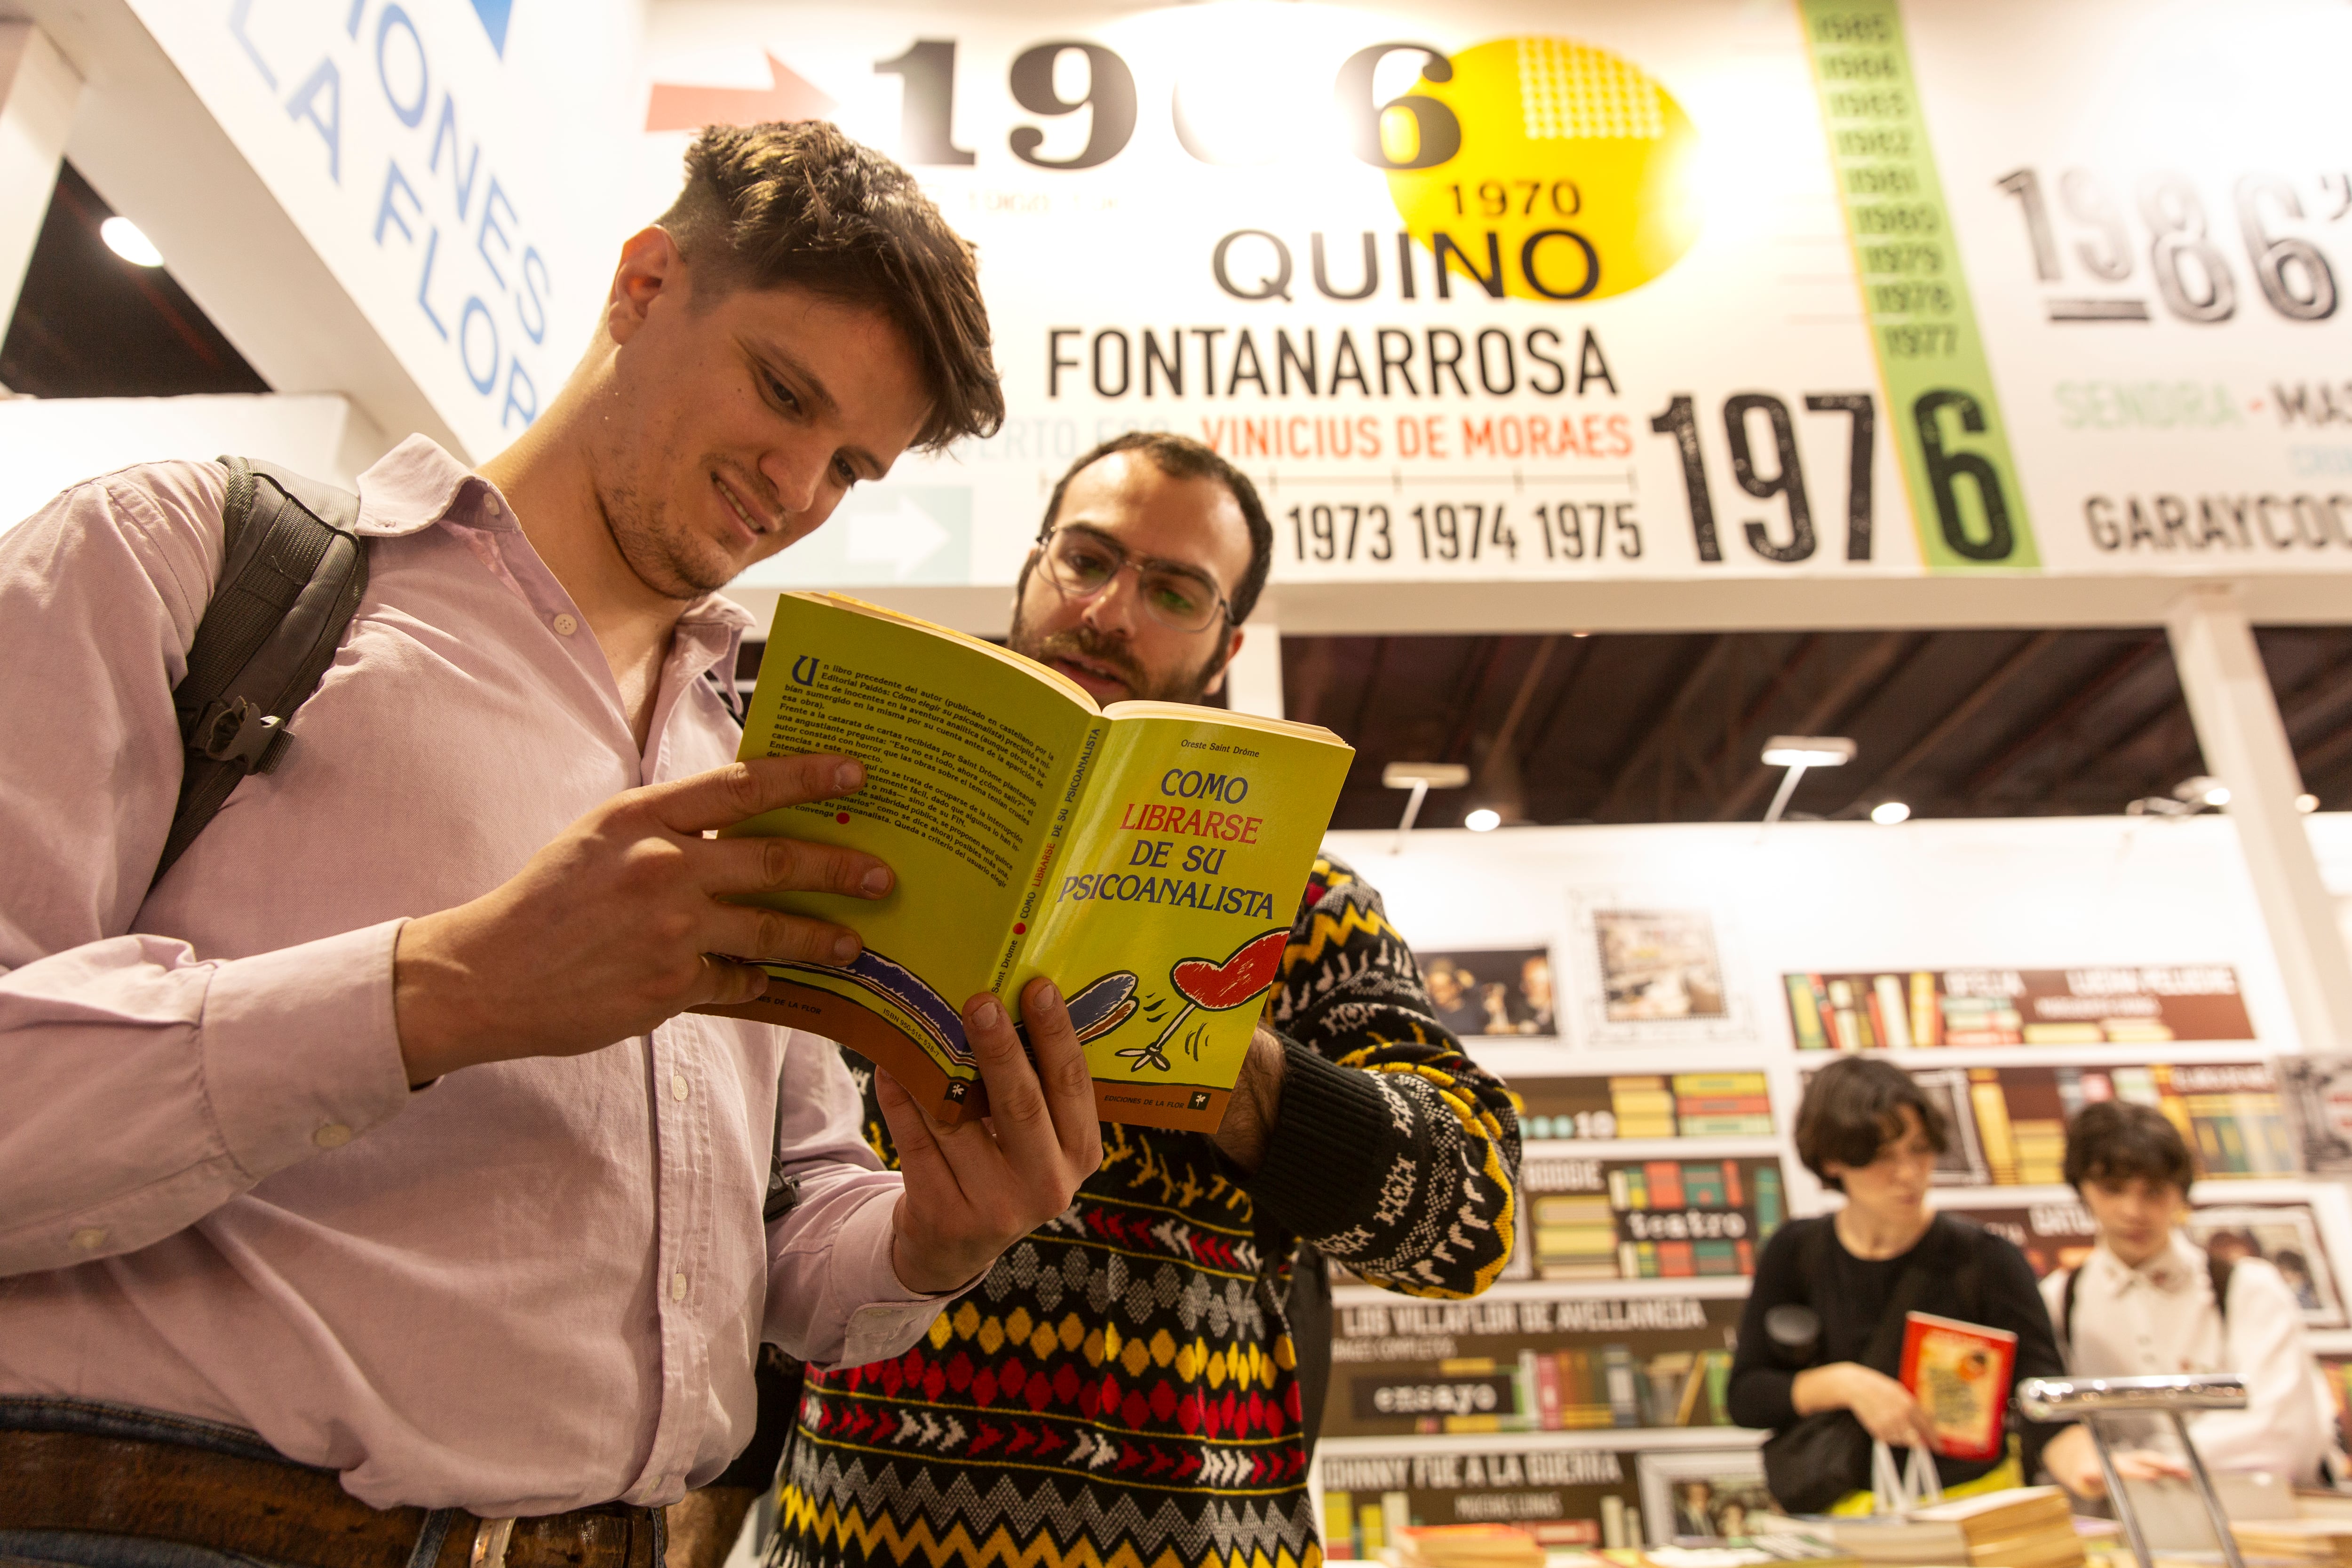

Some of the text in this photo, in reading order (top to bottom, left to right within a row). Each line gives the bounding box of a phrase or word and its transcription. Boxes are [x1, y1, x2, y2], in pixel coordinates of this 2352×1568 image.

[874, 37, 1462, 170] 196
[1449, 182, 1581, 215] 1970
[1213, 228, 1601, 303] QUINO
[1049, 327, 1618, 398] FONTANARROSA
[1201, 416, 1380, 459] VINICIUS
[1397, 416, 1447, 459] DE
[1462, 415, 1633, 458] MORAES
[1649, 389, 2017, 563] 1976
[1288, 502, 1643, 561] 1973 1974 1975
[781, 694, 825, 710] esa obra).
[821, 672, 858, 688] Editorial
[859, 681, 891, 696] Paidós:
[892, 691, 917, 704] Cómo
[917, 700, 942, 712] elegir
[941, 708, 953, 717] su
[952, 713, 1005, 742] psicoanalista)
[1004, 738, 1035, 759] precipitó
[1040, 759, 1051, 770] mi-
[832, 664, 853, 676] libro
[854, 672, 903, 690] precedente
[904, 685, 919, 695] del
[920, 691, 944, 703] autor
[944, 698, 986, 721] (publicado
[987, 717, 998, 727] en
[999, 724, 1034, 748] castellano
[1034, 745, 1048, 756] por
[1047, 752, 1055, 762] la
[771, 732, 812, 746] carencias
[823, 744, 842, 753] este
[844, 748, 883, 764] respecto.
[777, 714, 794, 723] una
[794, 717, 845, 734] angustiante
[846, 730, 887, 745] pregunta:
[935, 756, 955, 771] todo,
[957, 767, 978, 781] ahora
[779, 702, 809, 716] Frente
[817, 711, 826, 720] la
[827, 715, 863, 728] catarata
[864, 723, 875, 732] de
[876, 727, 903, 740] cartas
[904, 736, 941, 753] recibidas
[941, 749, 957, 759] por
[957, 755, 978, 770] Saint
[978, 765, 1002, 784] Drôme
[1002, 780, 1037, 808] planteando
[784, 684, 804, 695] bían
[805, 690, 852, 706] sumergido
[866, 703, 875, 712] la
[876, 708, 906, 721] misma
[906, 716, 922, 726] por
[923, 722, 934, 731] su
[936, 727, 963, 742] cuenta
[964, 739, 985, 753] antes
[986, 749, 996, 758] de
[997, 754, 1005, 764] la
[1005, 760, 1035, 783] aparición
[1035, 780, 1044, 789] de
[816, 681, 830, 691] les
[831, 685, 843, 694] de
[843, 688, 885, 705] inocentes
[899, 702, 908, 712] la
[909, 707, 945, 724] aventura
[946, 720, 979, 739] analítica
[980, 734, 1009, 755] (aunque
[1009, 751, 1028, 766] otros
[1028, 764, 1037, 772] se
[1037, 768, 1047, 779] ha-
[1181, 740, 1260, 757] Oreste Saint Drôme
[773, 723, 798, 733] autor
[799, 729, 837, 742] constató
[838, 737, 854, 746] con
[855, 740, 883, 754] horror
[883, 749, 899, 759] que
[900, 753, 913, 763] las
[914, 759, 937, 772] obras
[937, 768, 960, 782] sobre
[968, 782, 987, 797] tema
[987, 792, 1008, 810] tenían
[1008, 807, 1030, 826] crueles
[1161, 768, 1248, 804] COMO
[908, 796, 926, 807] sino
[927, 804, 938, 813] de
[939, 810, 949, 819] su
[951, 814, 966, 828] FIN.
[1020, 728, 1101, 919] COMO LIBRARSE DE SU PSICOANALISTA
[1120, 804, 1263, 844] LIBRARSE
[1129, 840, 1226, 875] DE SU
[1057, 874, 1273, 920] PSICOANALISTA
[991, 940, 1017, 994] Saint Drôme
[774, 998, 785, 1006] DE
[801, 1004, 821, 1015] FLOR
[882, 1008, 900, 1023] ISBN
[1104, 1095, 1142, 1104] EDICIONES
